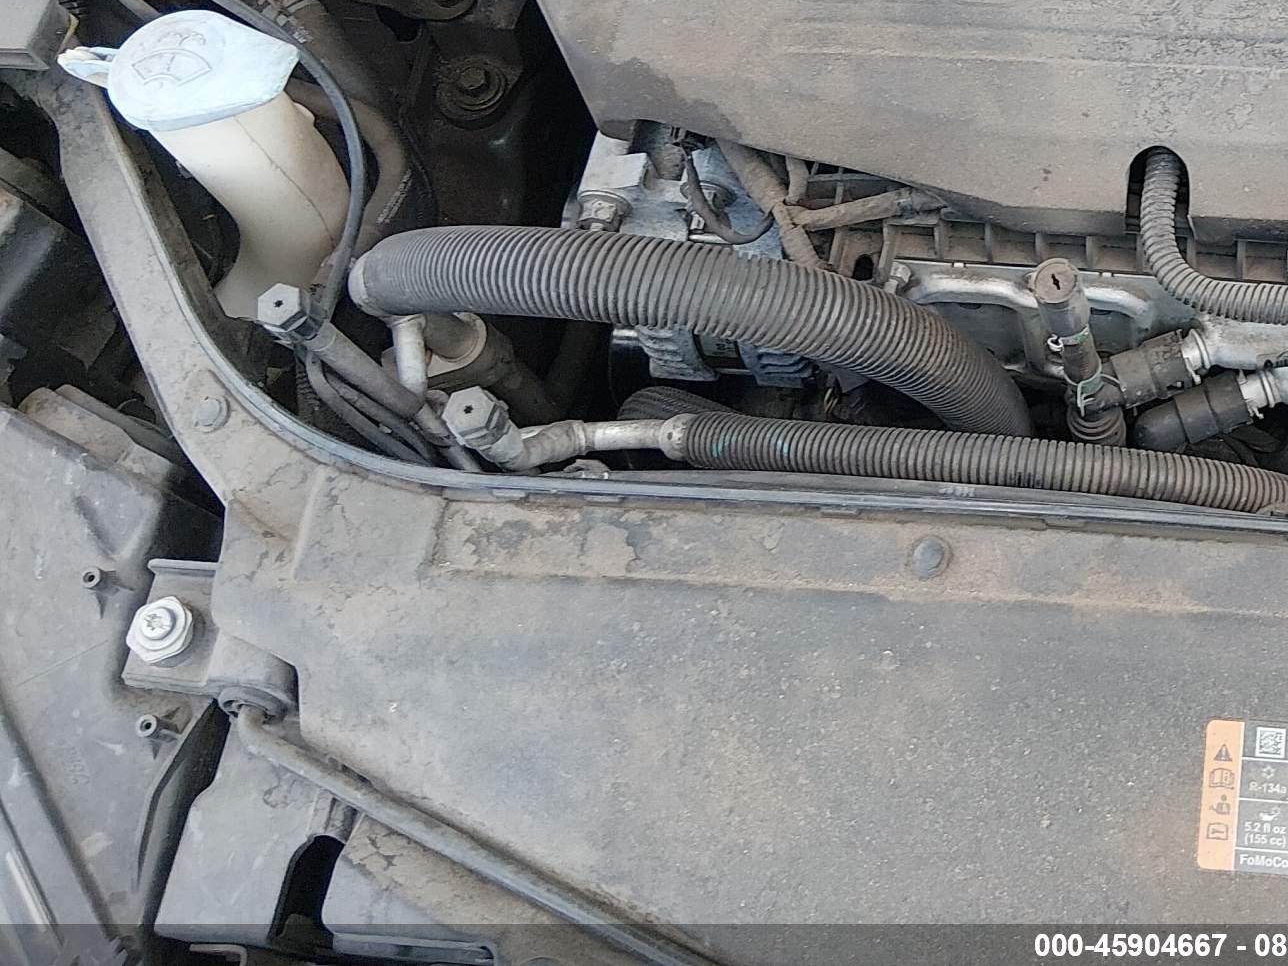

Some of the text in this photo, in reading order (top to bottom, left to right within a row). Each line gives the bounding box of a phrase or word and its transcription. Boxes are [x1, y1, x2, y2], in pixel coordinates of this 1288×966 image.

[1248, 781, 1287, 794] R-134a
[1244, 821, 1287, 835] 5.2 fl oz
[1244, 833, 1287, 849] (155 cc)
